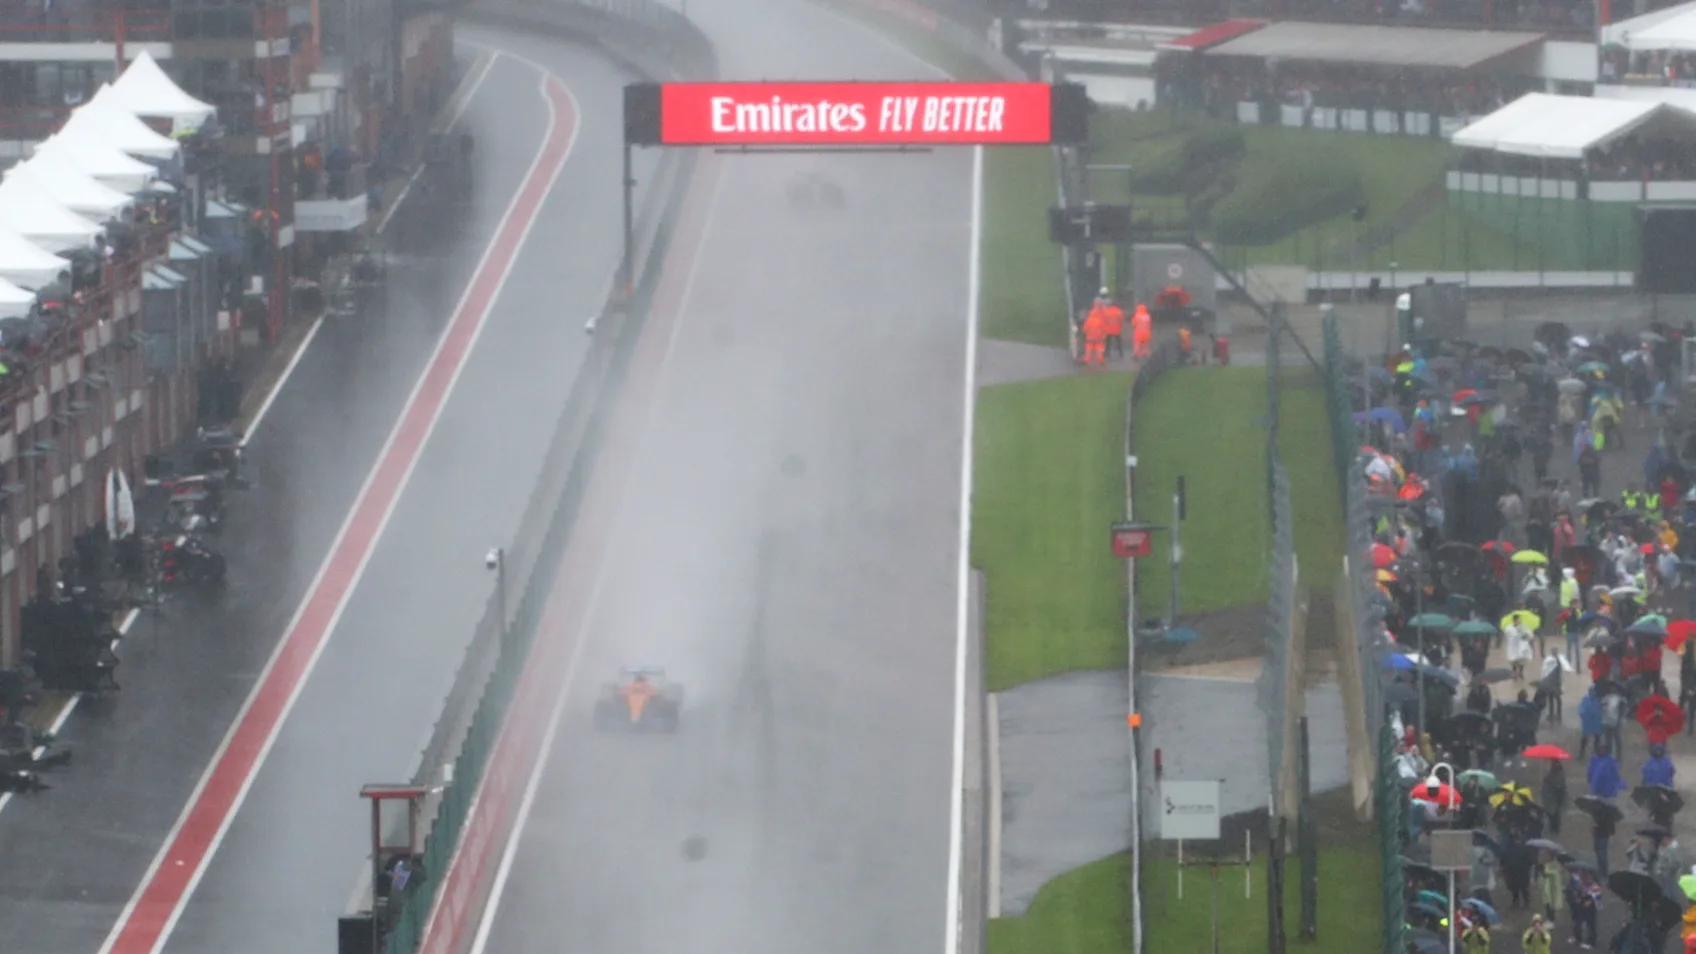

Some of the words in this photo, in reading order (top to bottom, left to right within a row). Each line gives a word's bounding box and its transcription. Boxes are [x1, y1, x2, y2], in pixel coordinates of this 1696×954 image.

[710, 95, 867, 133] Emirates
[879, 96, 917, 132] FLY
[922, 96, 1006, 132] BETTER
